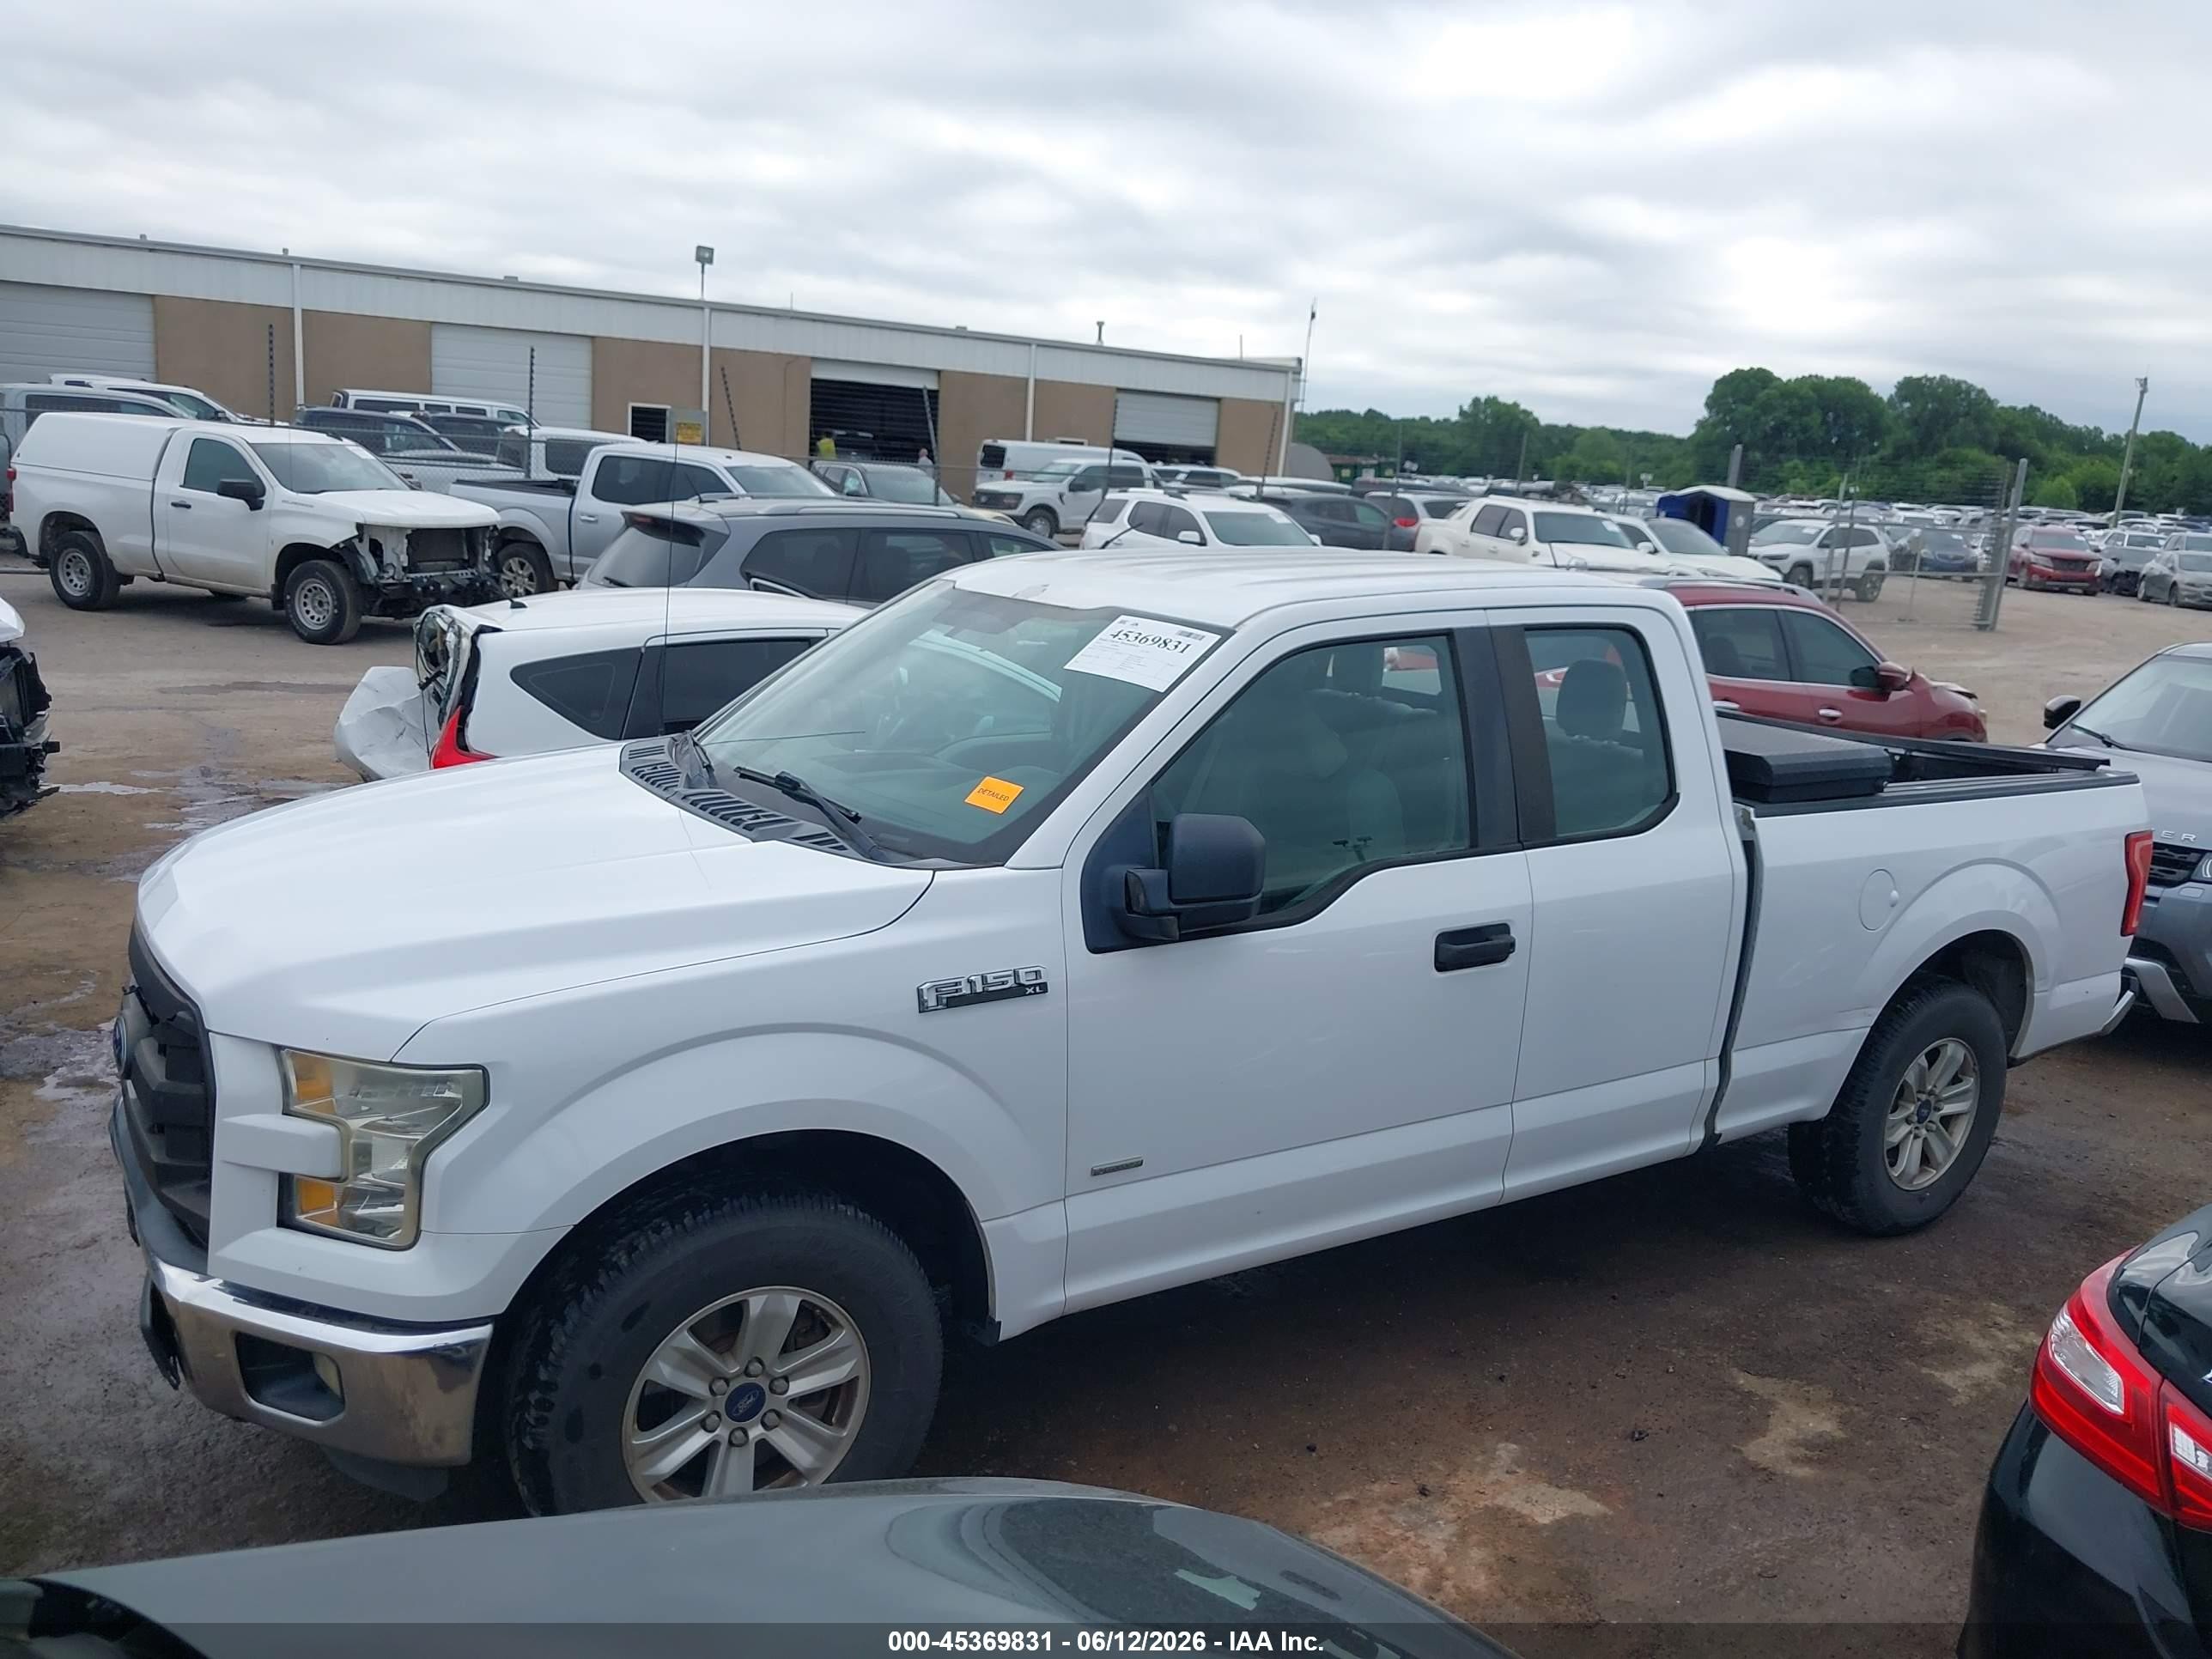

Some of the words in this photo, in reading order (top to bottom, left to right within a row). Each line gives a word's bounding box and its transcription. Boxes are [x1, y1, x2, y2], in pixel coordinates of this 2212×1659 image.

[1110, 629, 1192, 654] 45369831
[977, 787, 1010, 802] DETAILED
[2160, 830, 2197, 842] ER
